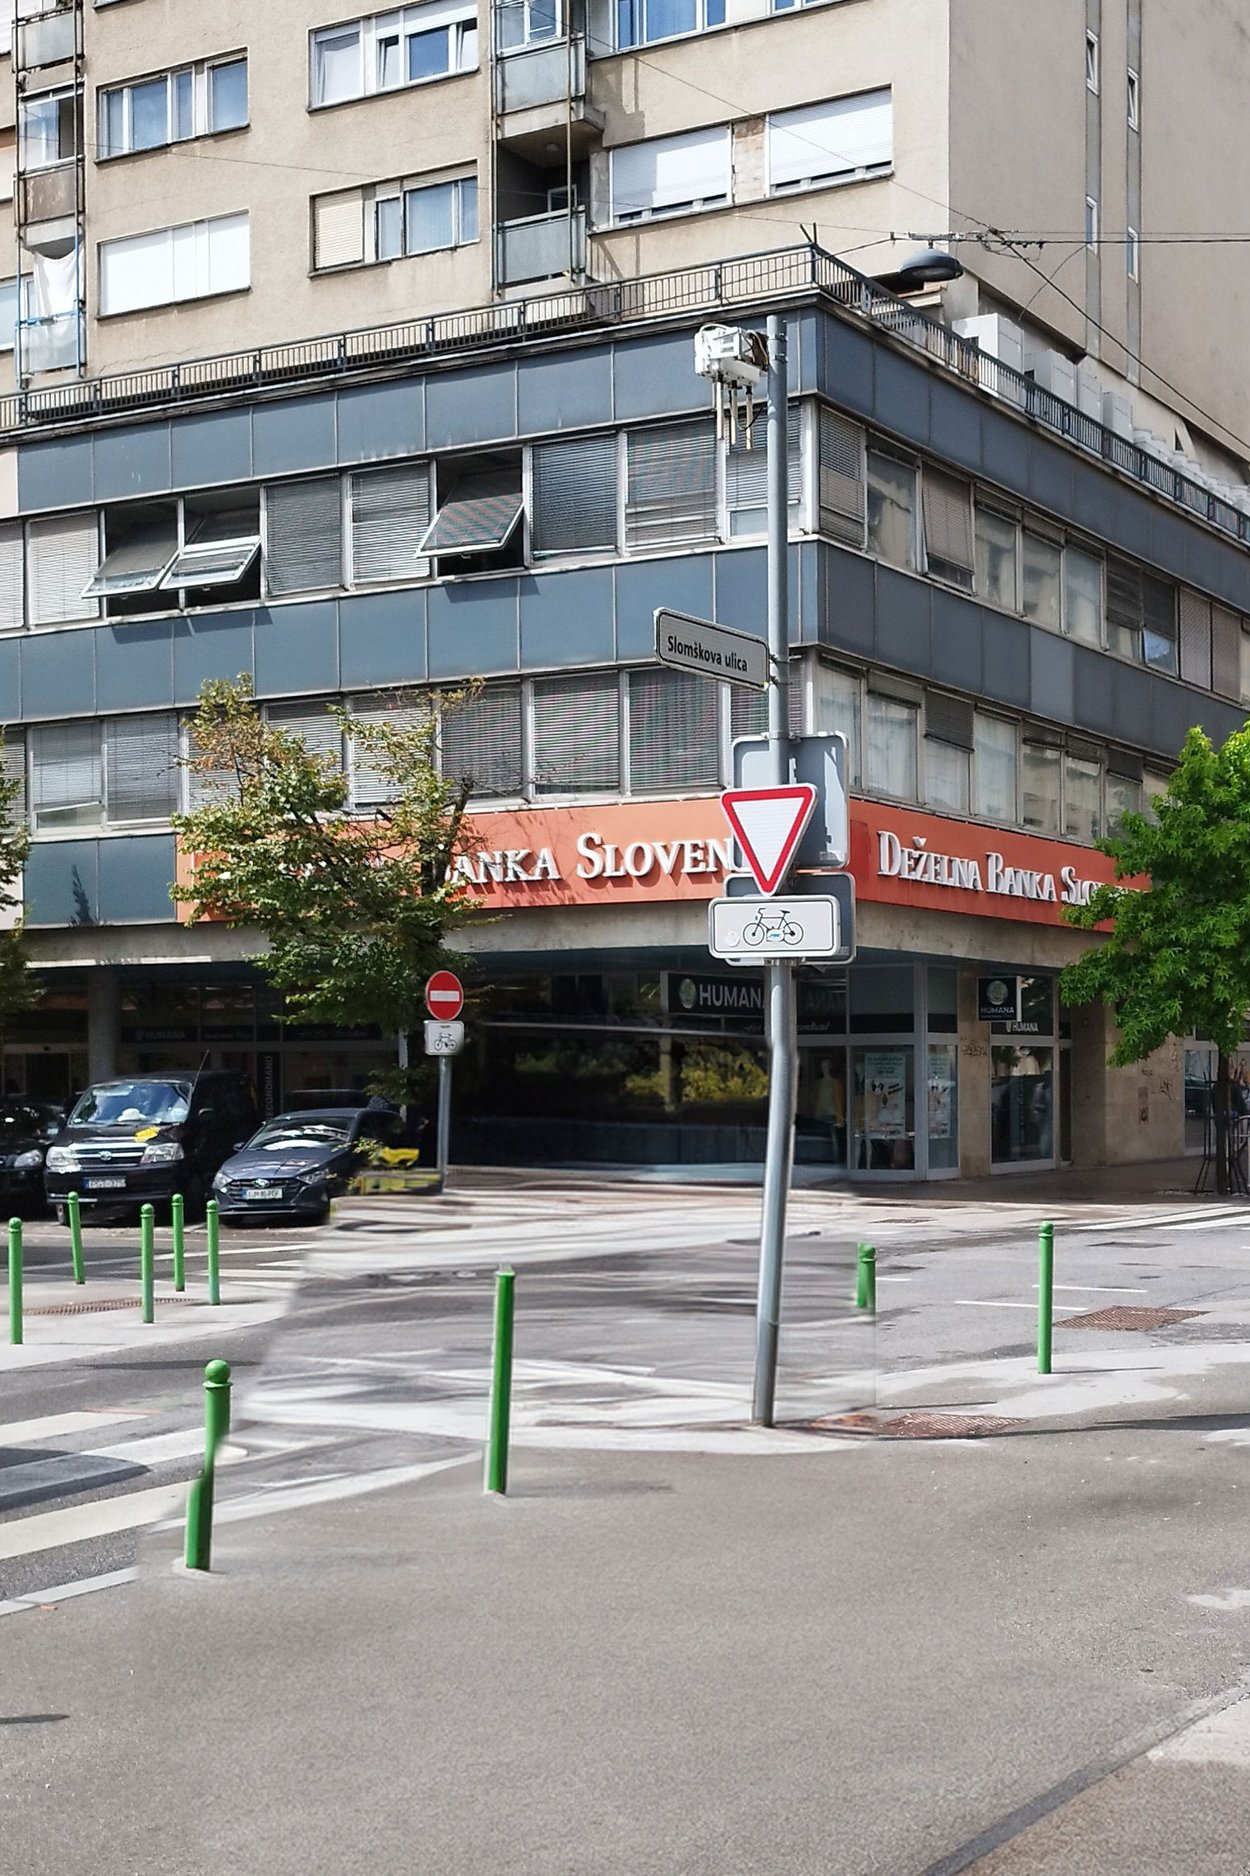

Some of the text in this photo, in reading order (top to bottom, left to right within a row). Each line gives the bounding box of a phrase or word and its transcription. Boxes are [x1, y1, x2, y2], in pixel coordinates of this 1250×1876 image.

[667, 635, 748, 672] Slomškova ulica
[442, 847, 561, 884] ANKA
[877, 830, 984, 892] DEŽELNA
[986, 851, 1058, 903] BANKA
[699, 983, 764, 1009] HUMAN
[980, 1006, 1015, 1014] HUMANA
[1012, 1022, 1039, 1032] HUMANA
